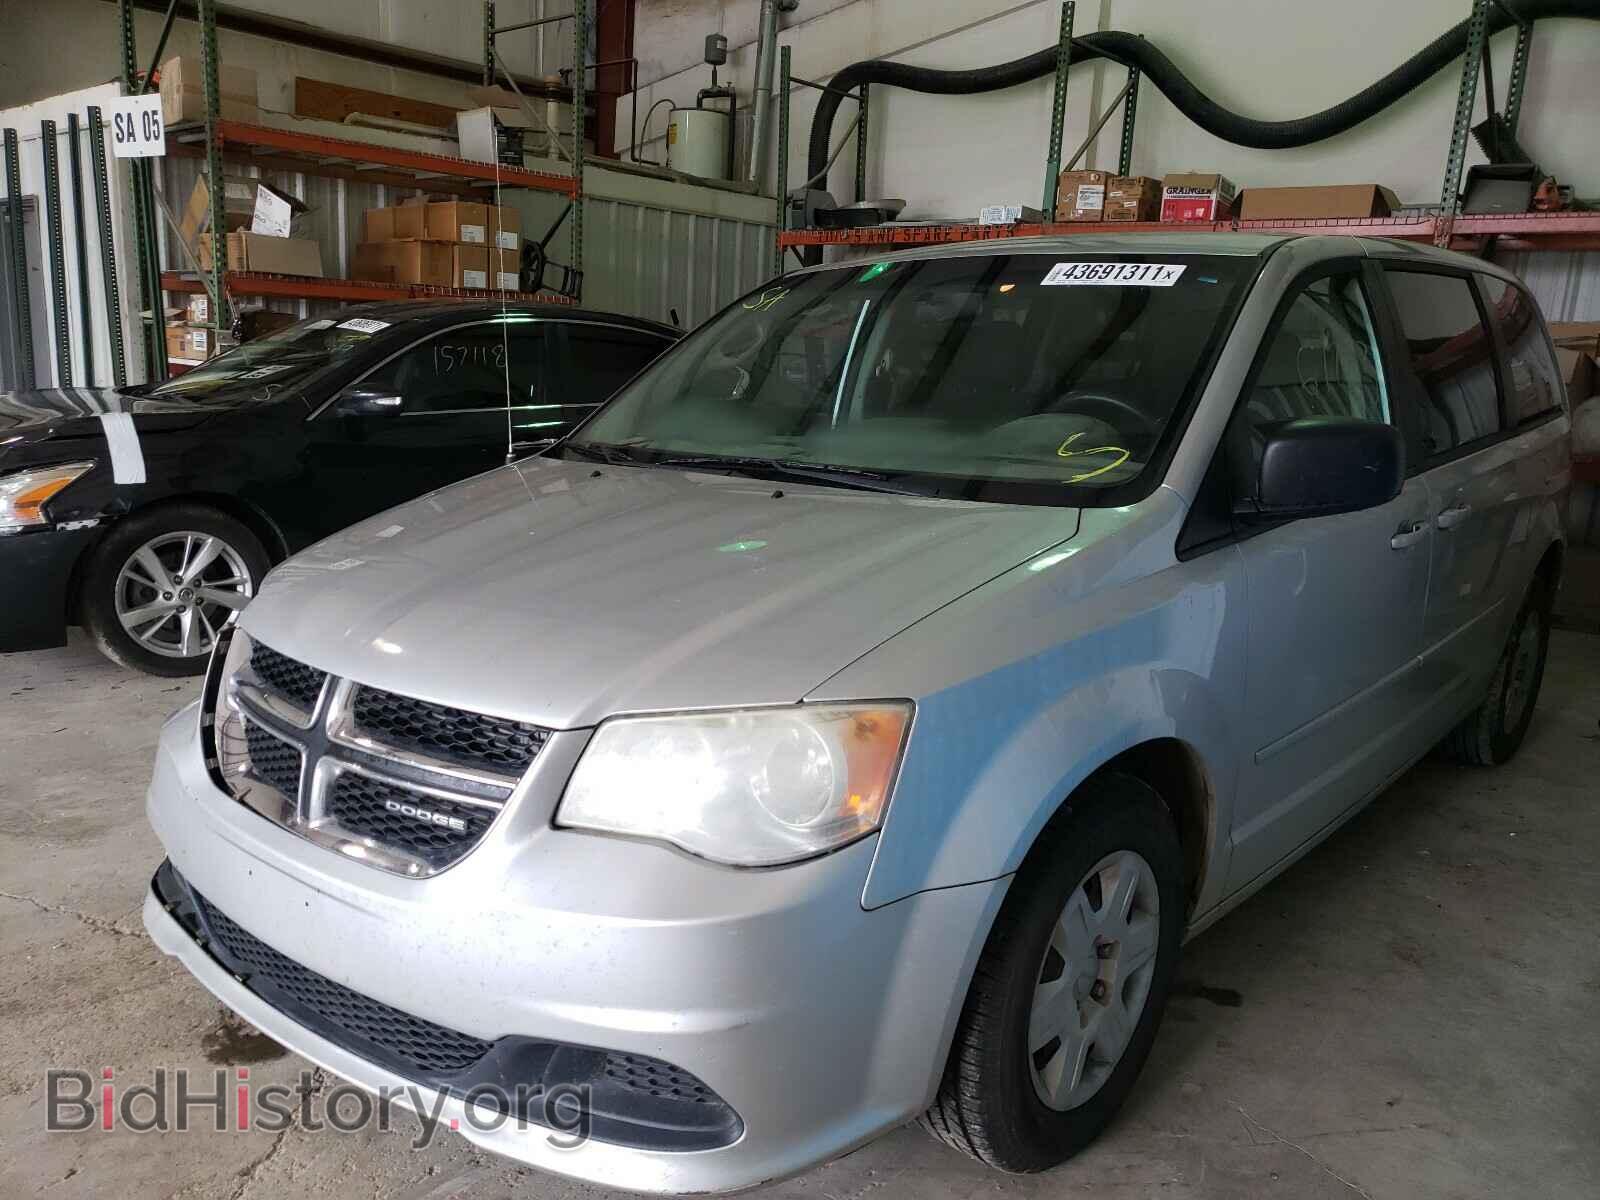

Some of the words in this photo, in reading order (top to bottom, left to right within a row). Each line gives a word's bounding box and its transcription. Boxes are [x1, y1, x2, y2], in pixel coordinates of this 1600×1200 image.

[114, 112, 137, 144] SA
[142, 109, 161, 142] 05
[903, 227, 952, 242] SPARE
[385, 800, 465, 831] DODGE
